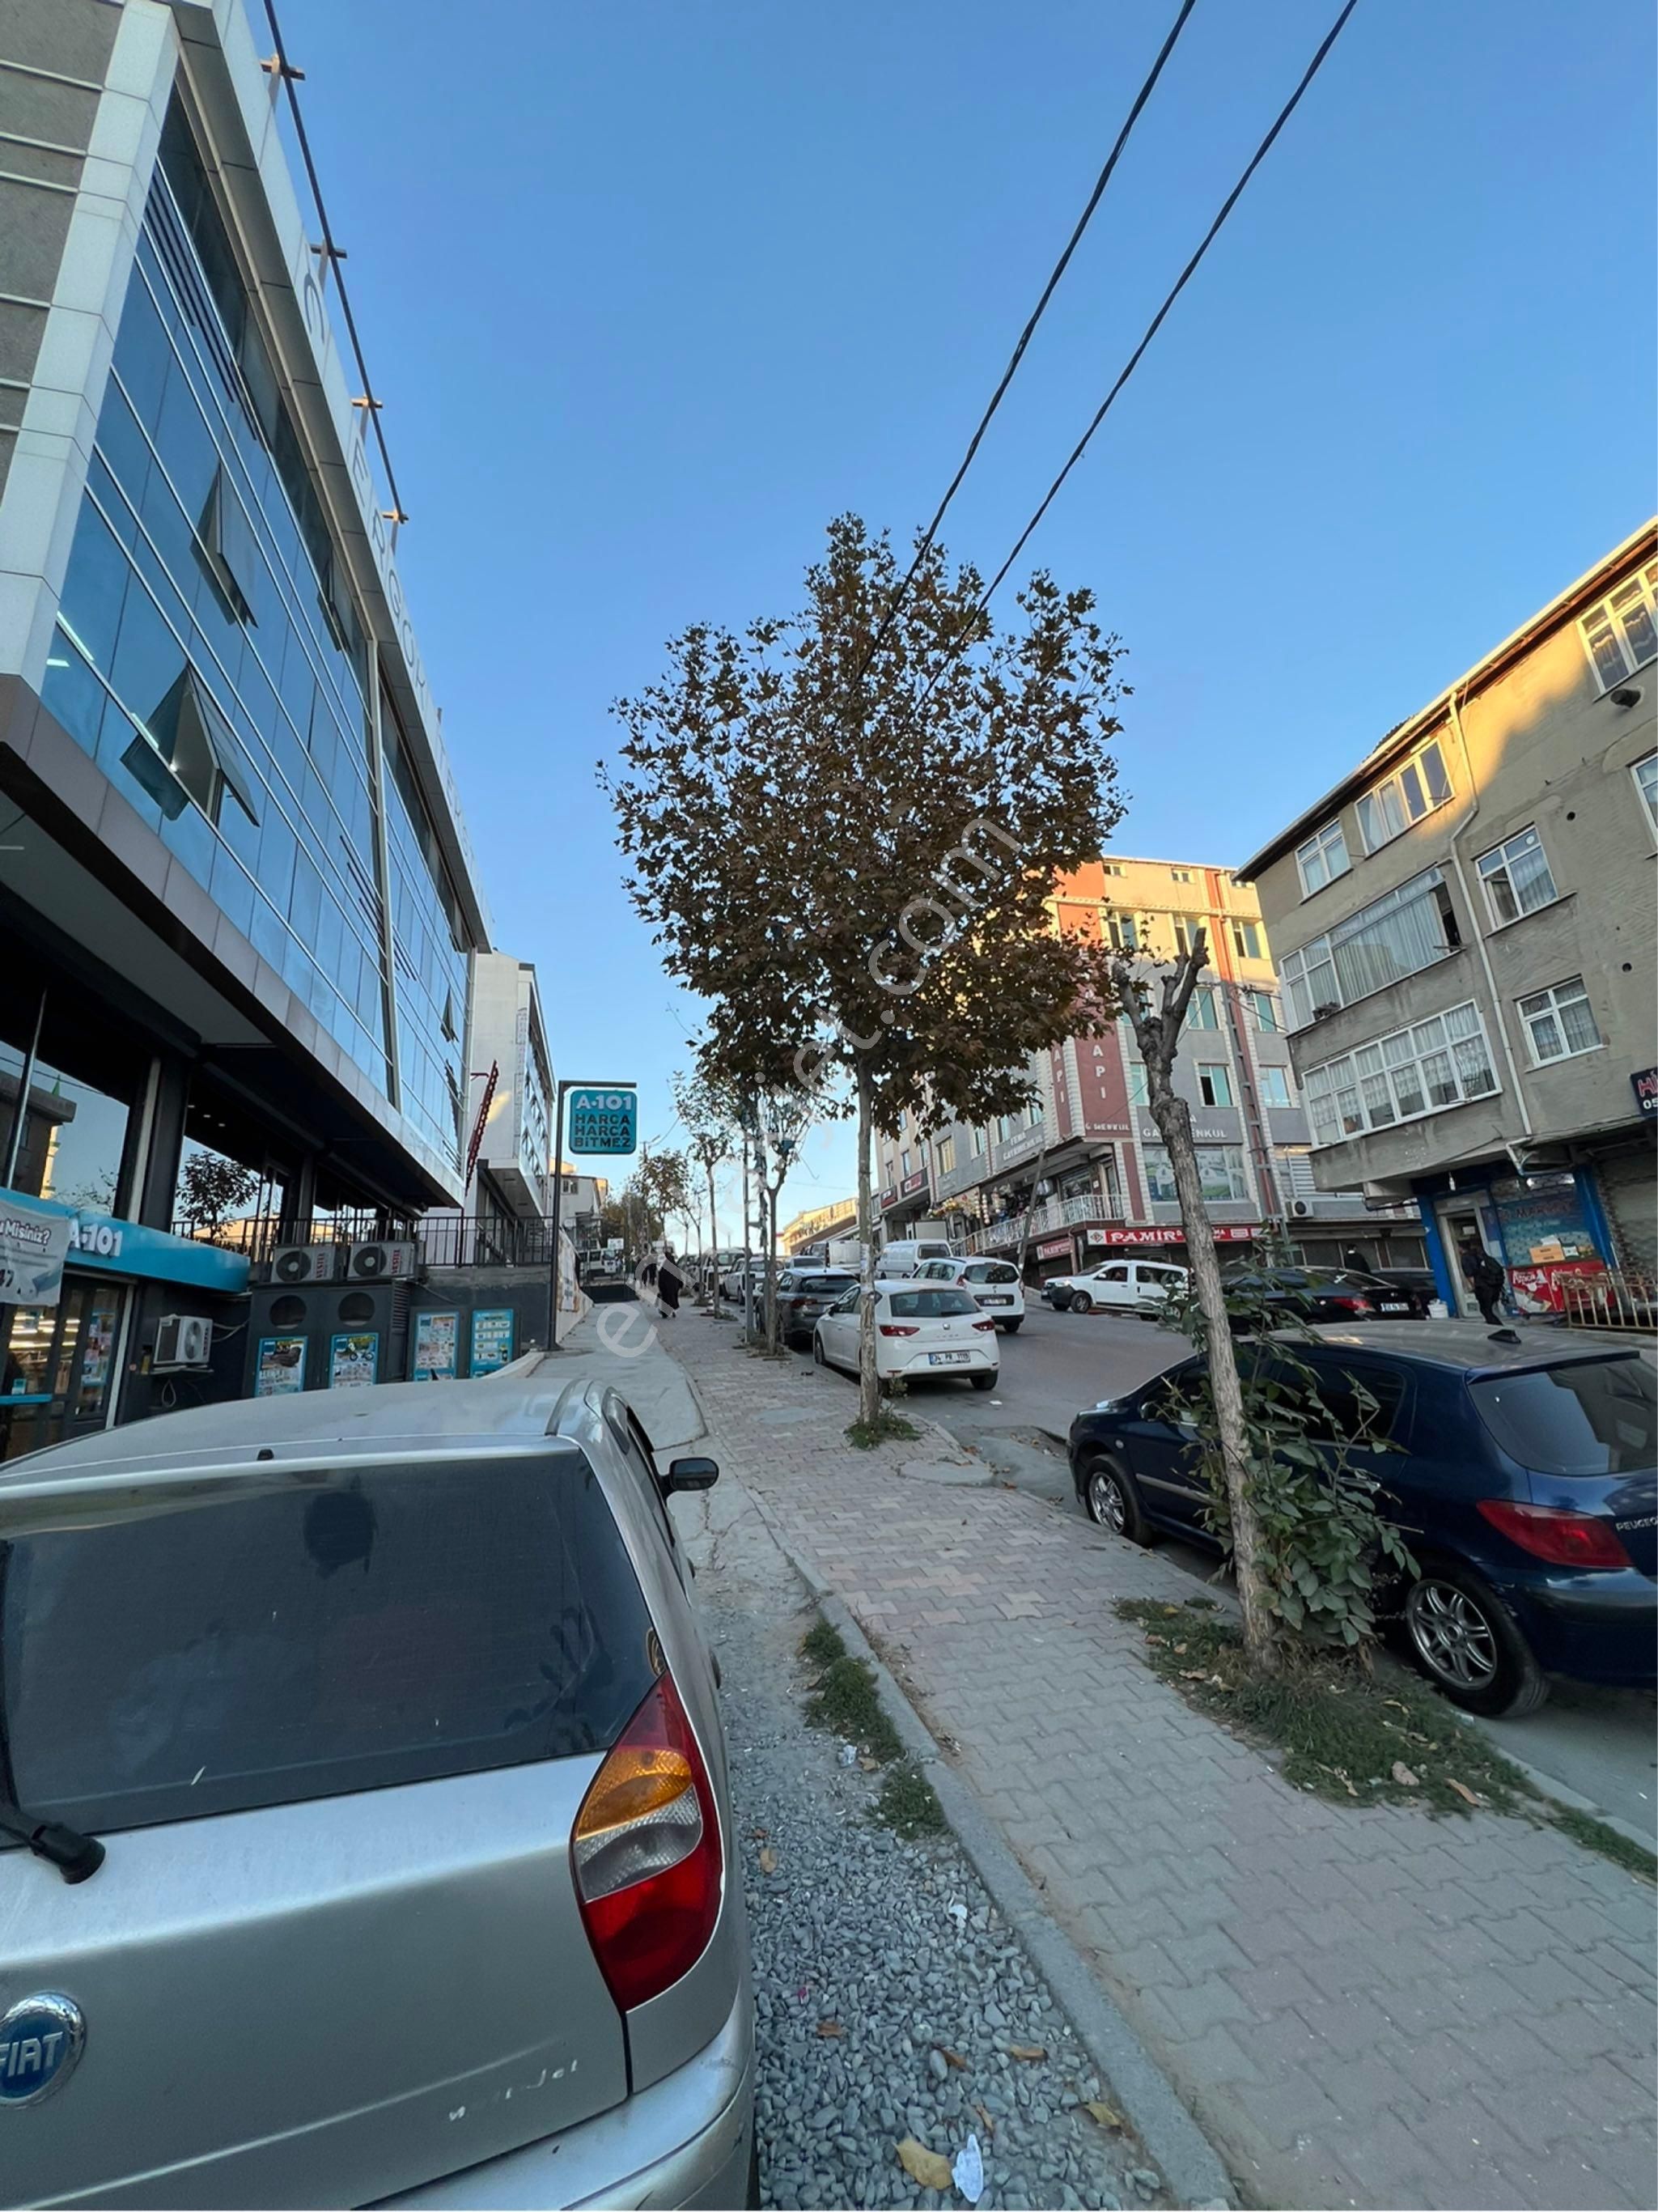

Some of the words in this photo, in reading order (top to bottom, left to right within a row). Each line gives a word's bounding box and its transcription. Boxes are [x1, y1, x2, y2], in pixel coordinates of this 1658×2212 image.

[575, 1114, 630, 1125] HARCA
[575, 1126, 630, 1136] HARCA
[5, 1219, 51, 1245] Misiniz?
[1111, 1229, 1177, 1242] PAMİR
